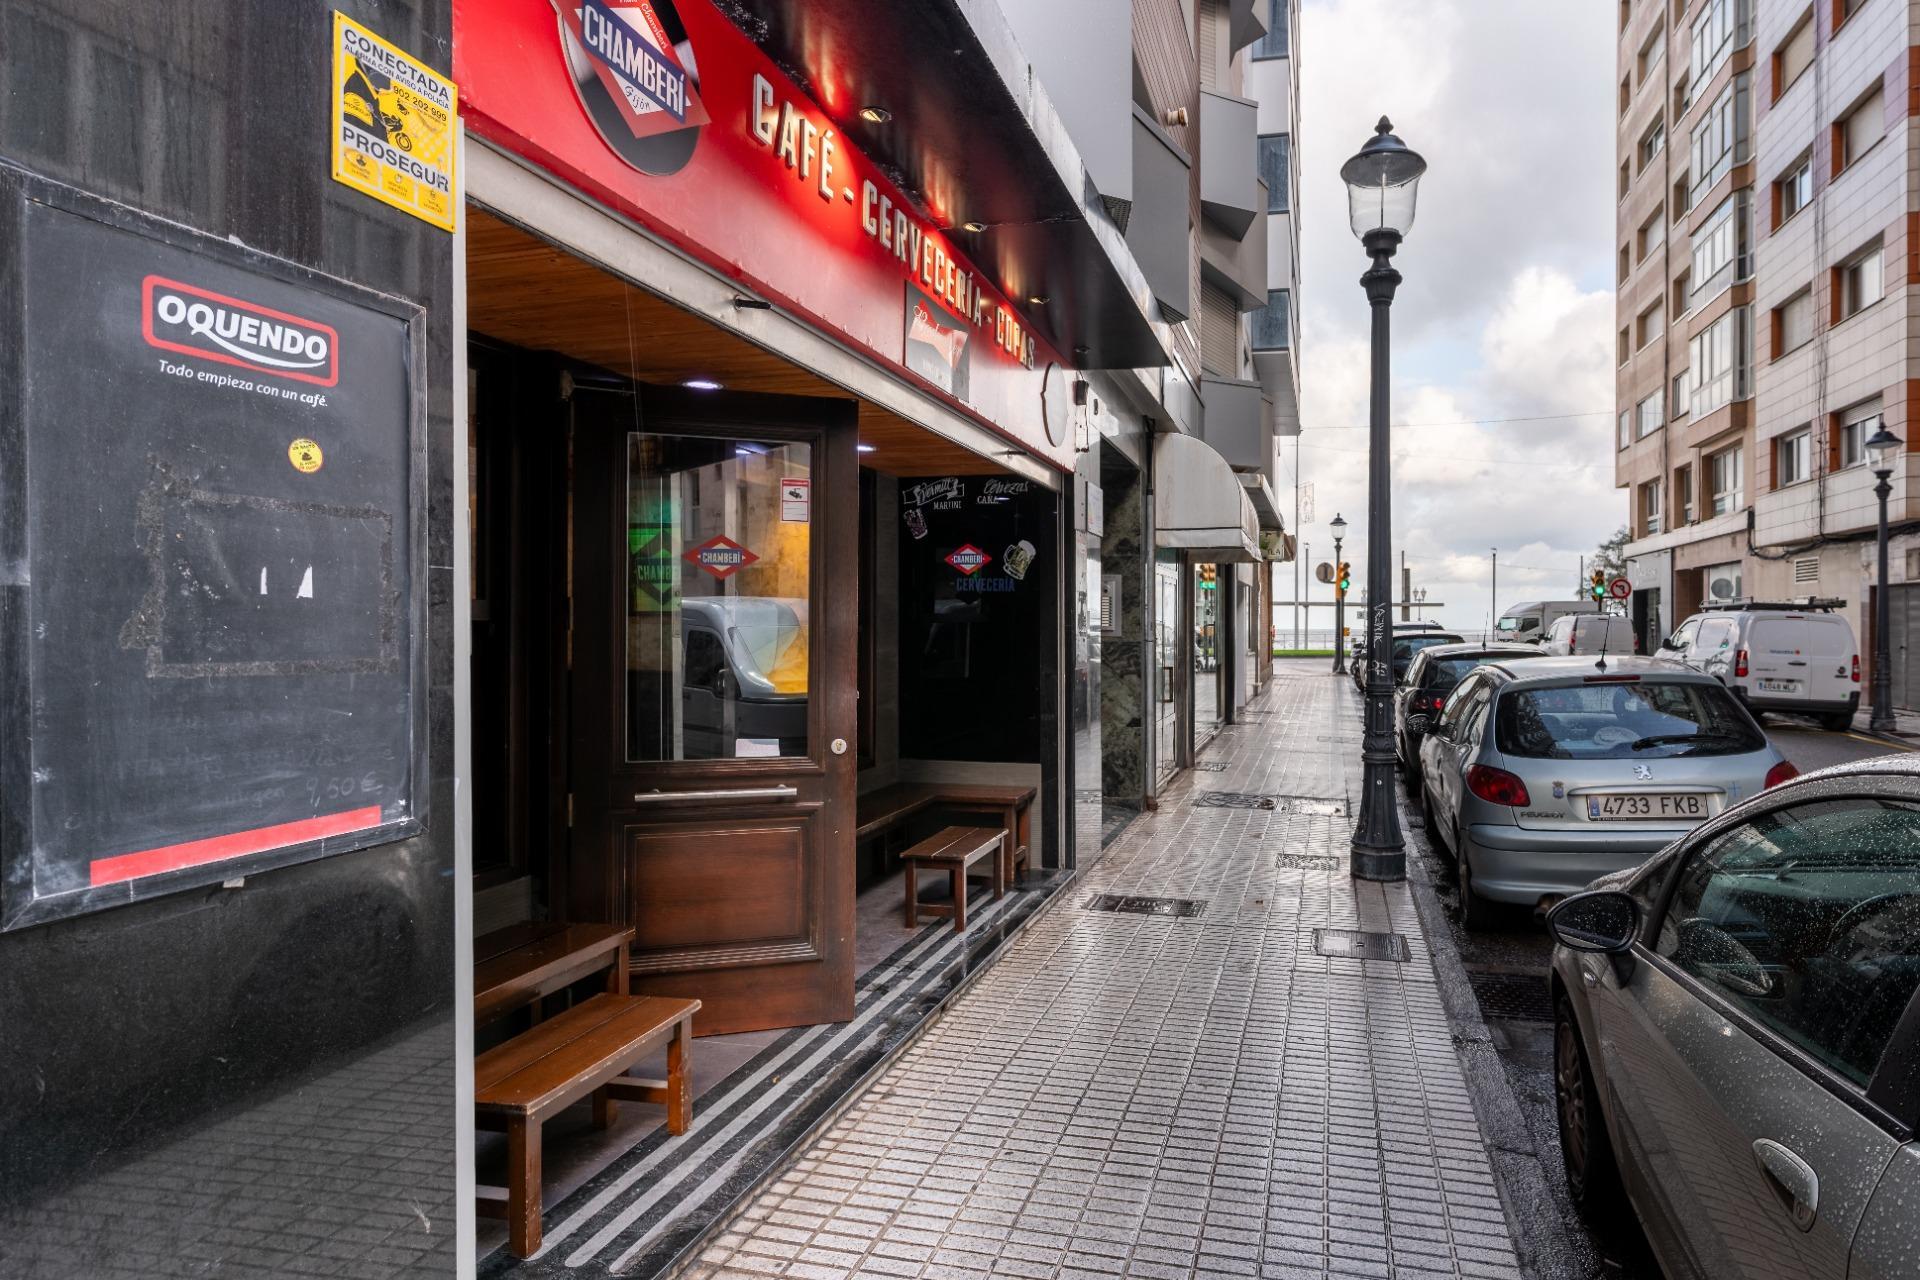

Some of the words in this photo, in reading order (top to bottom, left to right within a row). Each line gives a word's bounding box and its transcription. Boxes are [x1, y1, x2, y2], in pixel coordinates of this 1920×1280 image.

[344, 28, 450, 101] CONECTADA
[344, 44, 377, 69] ALARMA
[377, 62, 394, 79] CON
[396, 73, 417, 91] AVISO
[417, 86, 423, 96] A
[584, 4, 684, 117] CHAMBERÍ
[393, 85, 410, 102] 902
[412, 97, 429, 113] 202
[432, 108, 447, 122] 999
[343, 126, 449, 193] PROSEGUR
[753, 72, 835, 202] CAFÉ
[863, 178, 983, 328] CERVECERÍA
[995, 305, 1035, 371] COPAS
[157, 294, 328, 367] OQUENDO
[159, 359, 194, 378] Todo
[197, 368, 253, 391] empieza
[256, 384, 279, 397] con
[282, 389, 298, 401] un
[300, 392, 328, 408] café.
[701, 551, 741, 564] CHAMBERÍ
[1603, 797, 1651, 815] 4733
[1660, 796, 1699, 815] FKB
